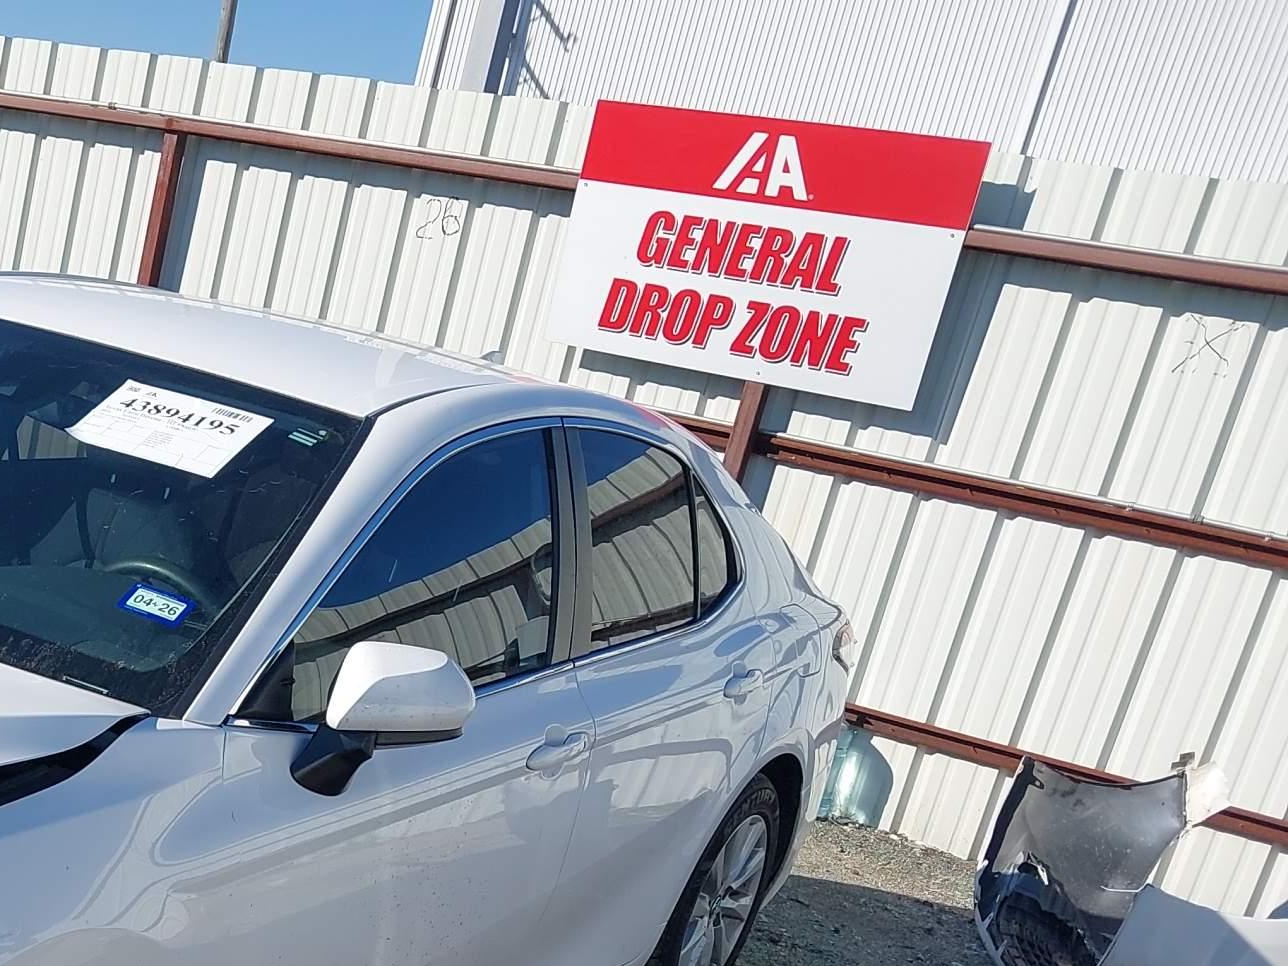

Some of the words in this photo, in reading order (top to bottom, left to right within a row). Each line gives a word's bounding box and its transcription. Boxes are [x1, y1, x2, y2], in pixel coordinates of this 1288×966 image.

[636, 210, 851, 296] GENERAL
[597, 278, 737, 350] DROP
[728, 300, 868, 376] ZONE
[119, 398, 241, 435] 43894195
